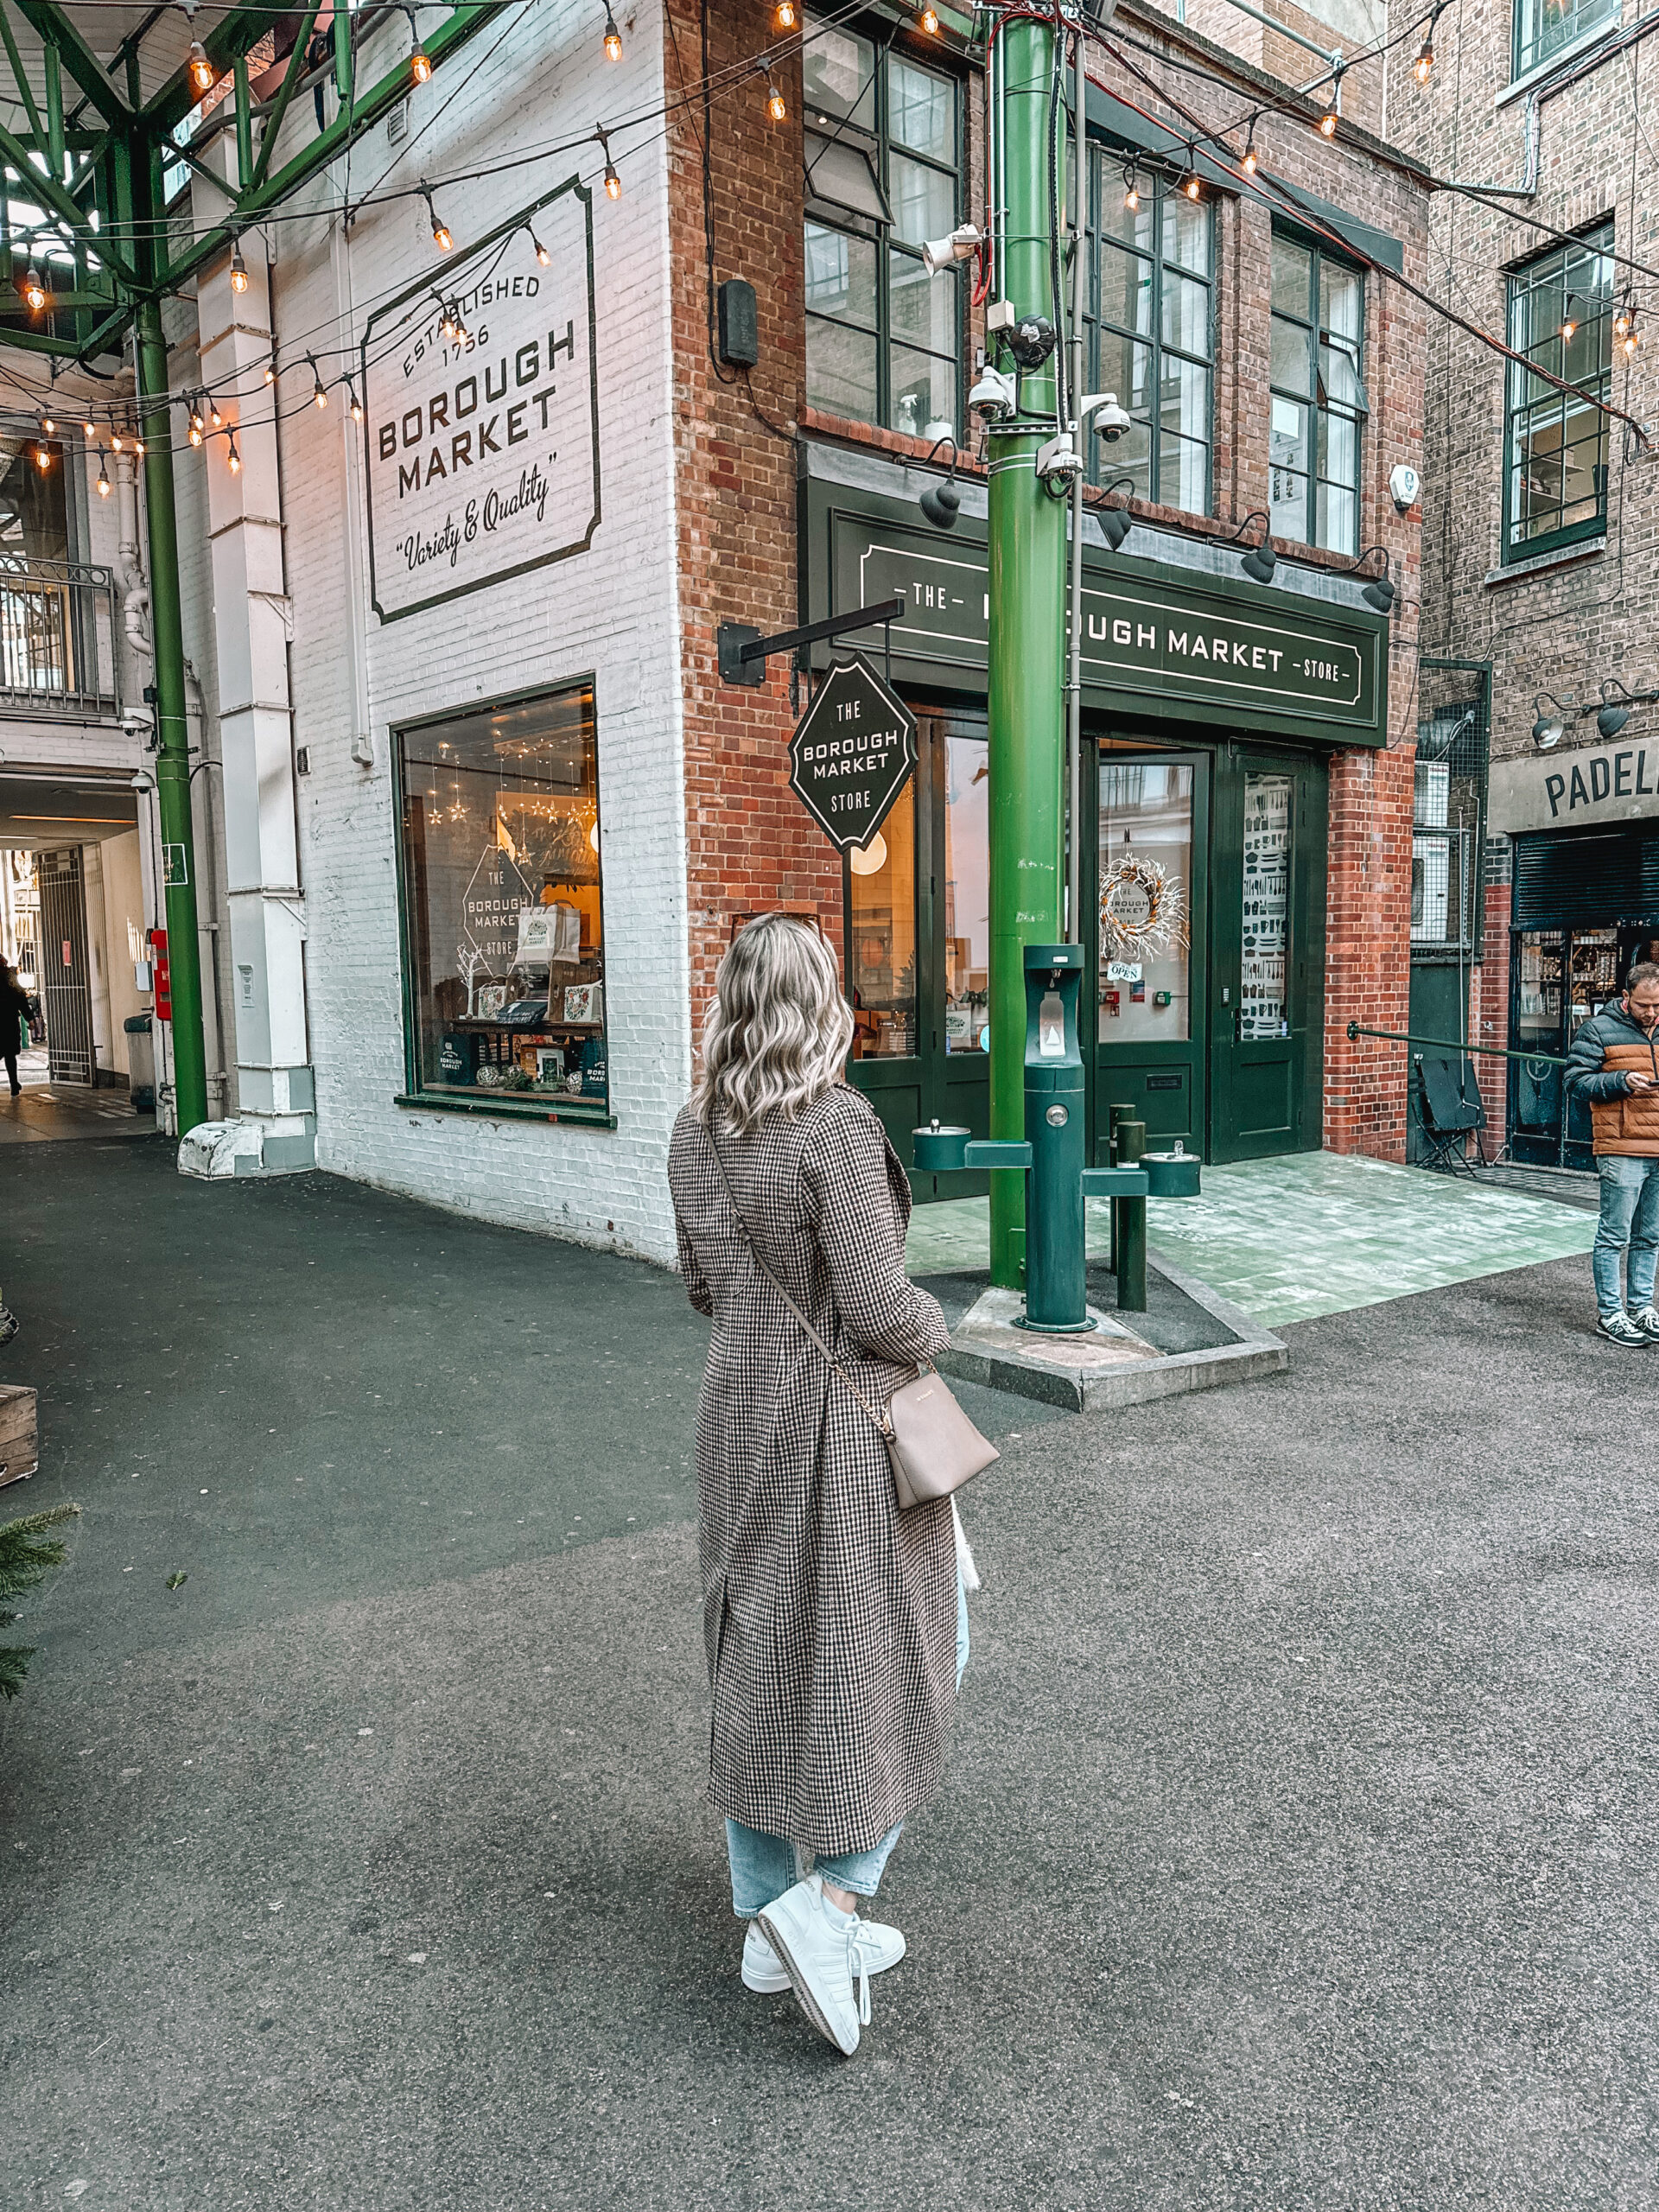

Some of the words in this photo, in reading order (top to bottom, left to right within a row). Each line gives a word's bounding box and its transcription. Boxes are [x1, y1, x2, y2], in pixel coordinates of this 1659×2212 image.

[442, 324, 489, 367] 1756
[378, 319, 575, 462] BOROUGH
[398, 385, 556, 499] MARKET
[464, 499, 480, 543] &
[1167, 629, 1284, 672] MARKET
[836, 700, 861, 722] THE
[804, 729, 898, 762] BOROUGH
[813, 753, 889, 779] MARKET
[1544, 749, 1659, 818] PADEL
[830, 790, 871, 812] STORE
[488, 871, 505, 886] THE
[468, 898, 528, 913] BOROUGH
[486, 941, 512, 957] STORE
[1111, 965, 1137, 979] OPEN
